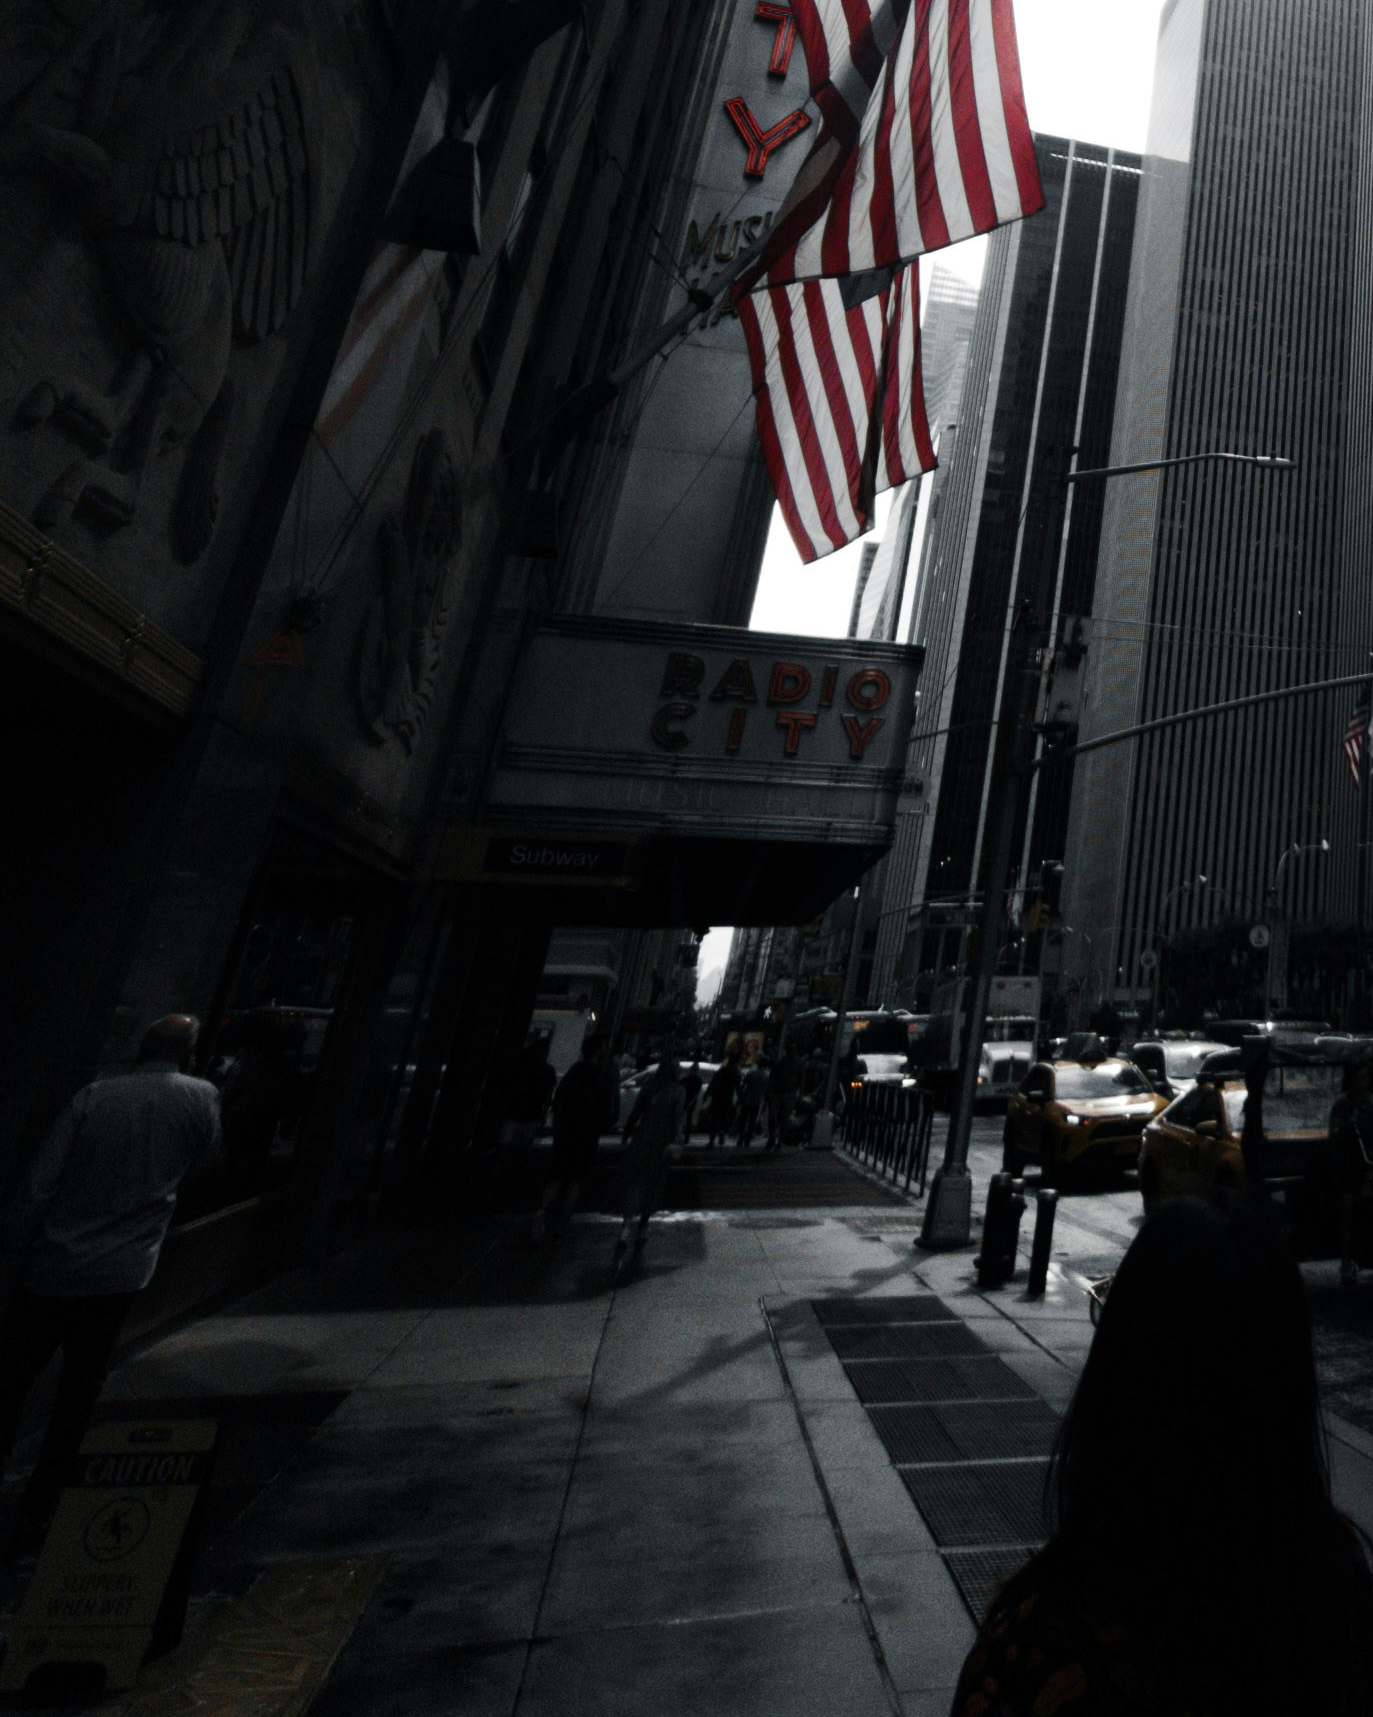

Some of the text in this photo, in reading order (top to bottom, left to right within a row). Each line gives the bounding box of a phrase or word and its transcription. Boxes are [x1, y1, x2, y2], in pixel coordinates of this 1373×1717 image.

[659, 651, 892, 713] RADIO
[651, 701, 884, 760] CITY
[510, 844, 600, 869] Subway
[83, 1453, 195, 1484] CAUTION
